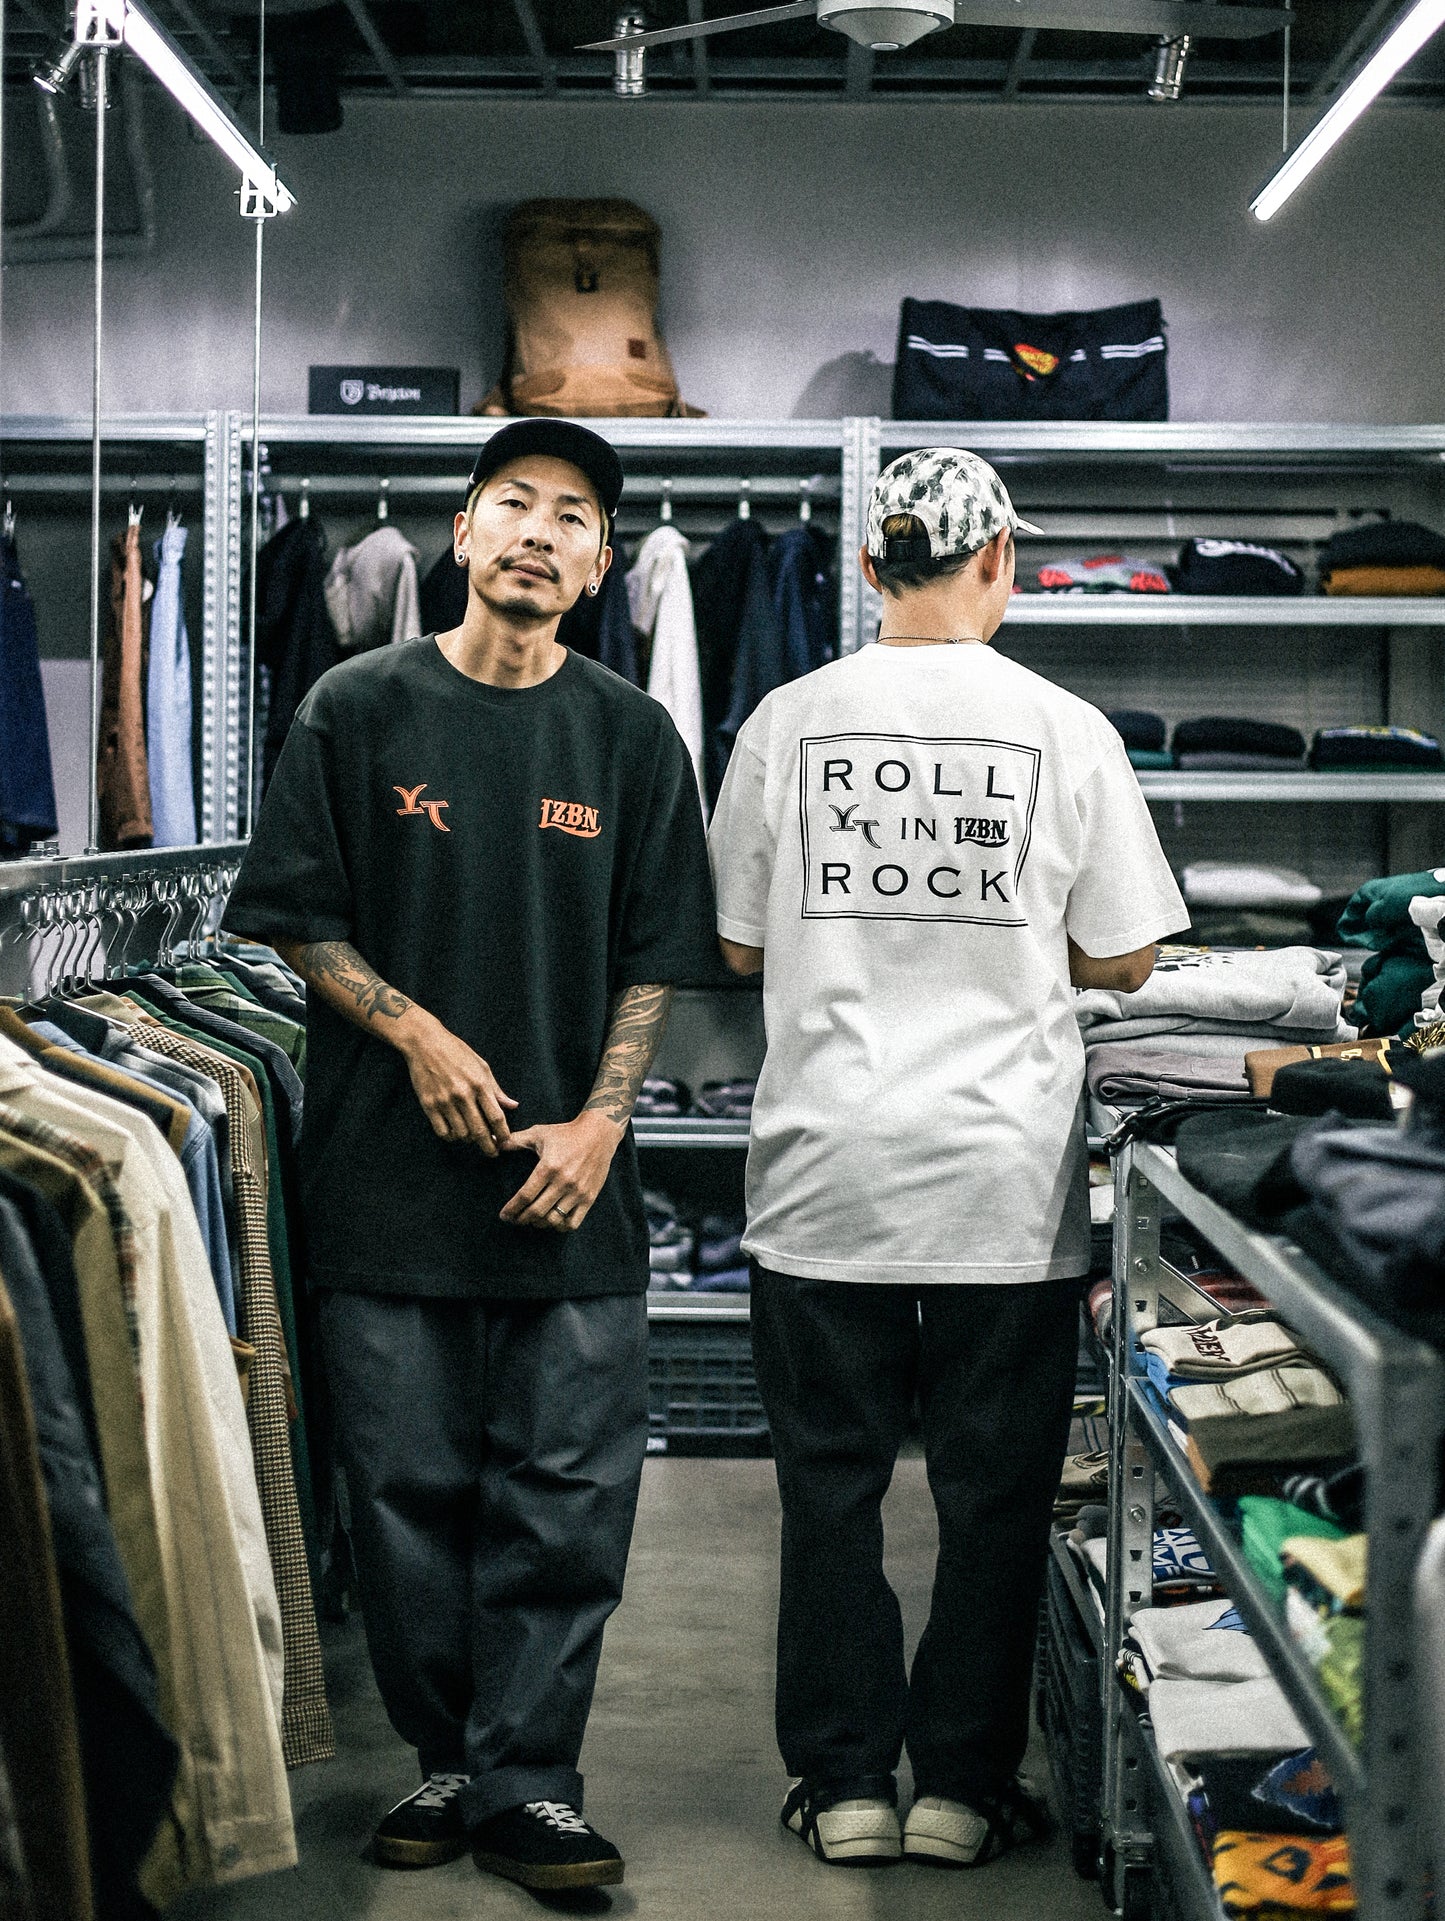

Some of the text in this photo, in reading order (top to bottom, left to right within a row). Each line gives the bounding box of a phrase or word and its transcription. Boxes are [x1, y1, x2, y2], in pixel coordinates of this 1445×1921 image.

[822, 759, 1015, 800] ROLL
[901, 817, 937, 841] IN
[821, 862, 1010, 903] ROCK
